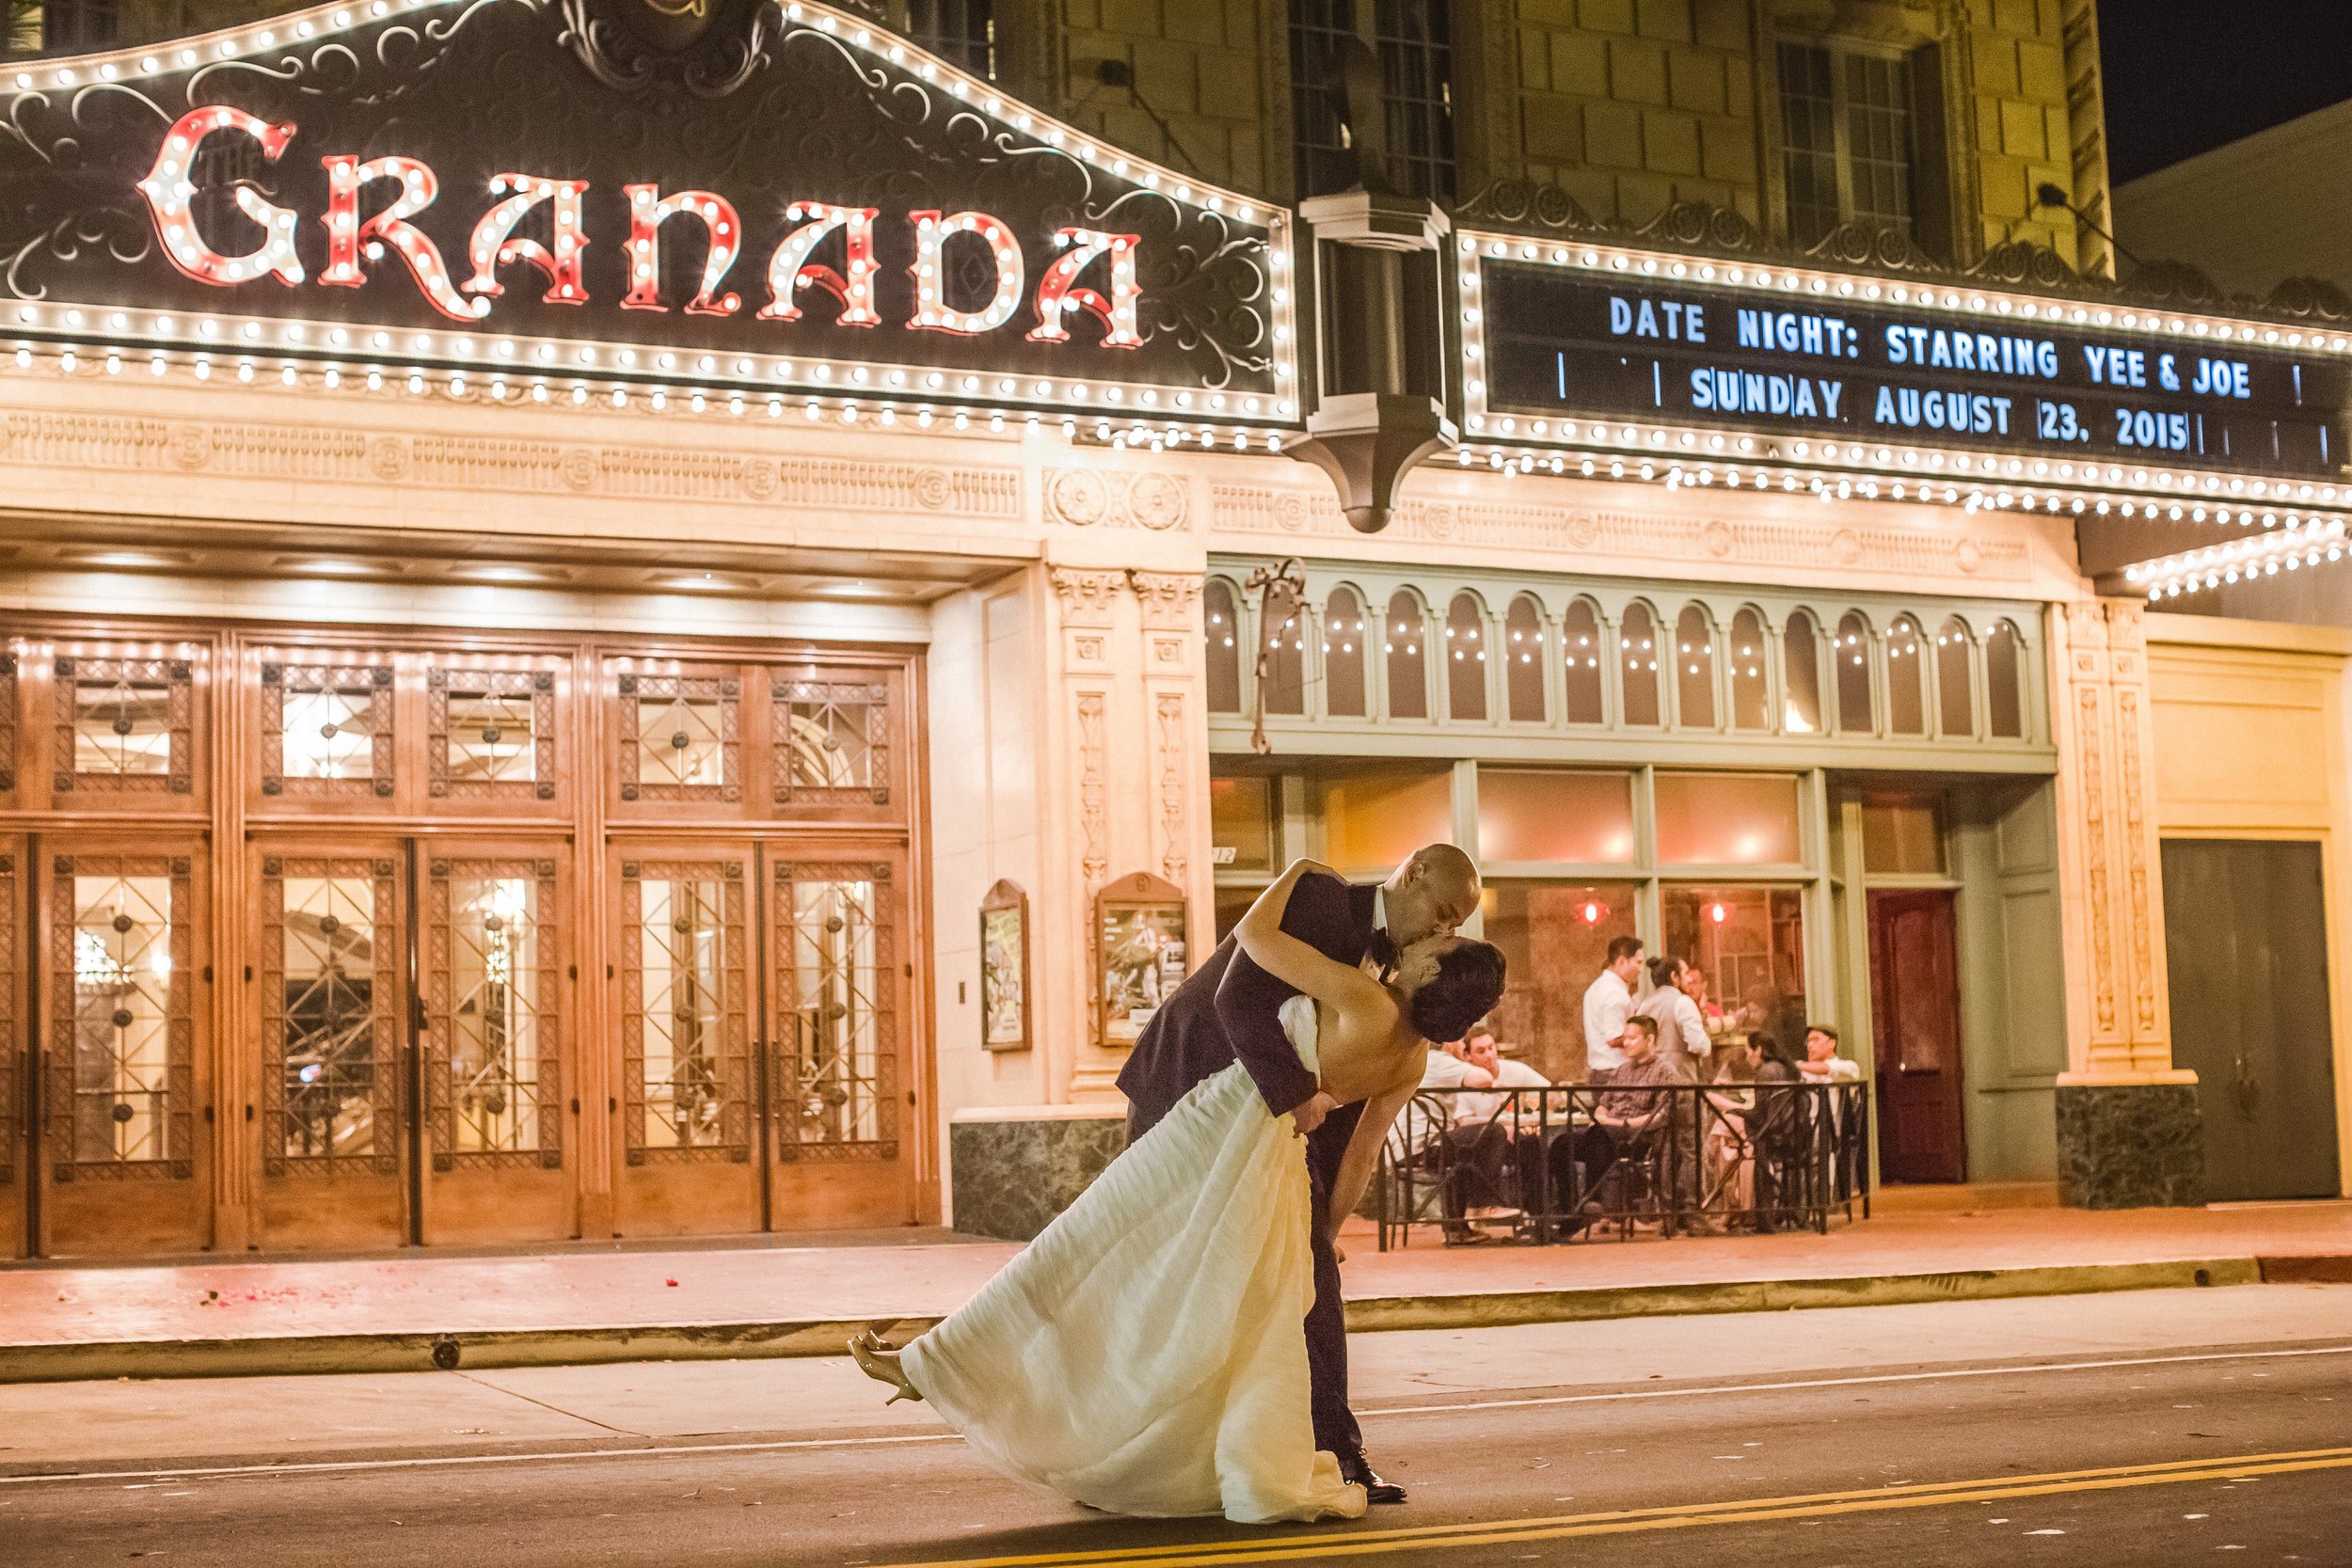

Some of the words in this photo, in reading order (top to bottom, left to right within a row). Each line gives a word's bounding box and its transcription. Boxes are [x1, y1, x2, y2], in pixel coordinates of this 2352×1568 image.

[135, 104, 1144, 350] GRANADA
[1610, 296, 1707, 343] DATE
[1737, 309, 1859, 358] NIGHT:
[1884, 325, 2058, 378] STARRING
[2083, 345, 2147, 388] YEE
[2158, 353, 2181, 391] &
[2191, 357, 2251, 399] JOE
[1691, 368, 1842, 420] SUNDAY
[1875, 386, 2011, 435] AUGUST
[2116, 408, 2188, 451] 2015
